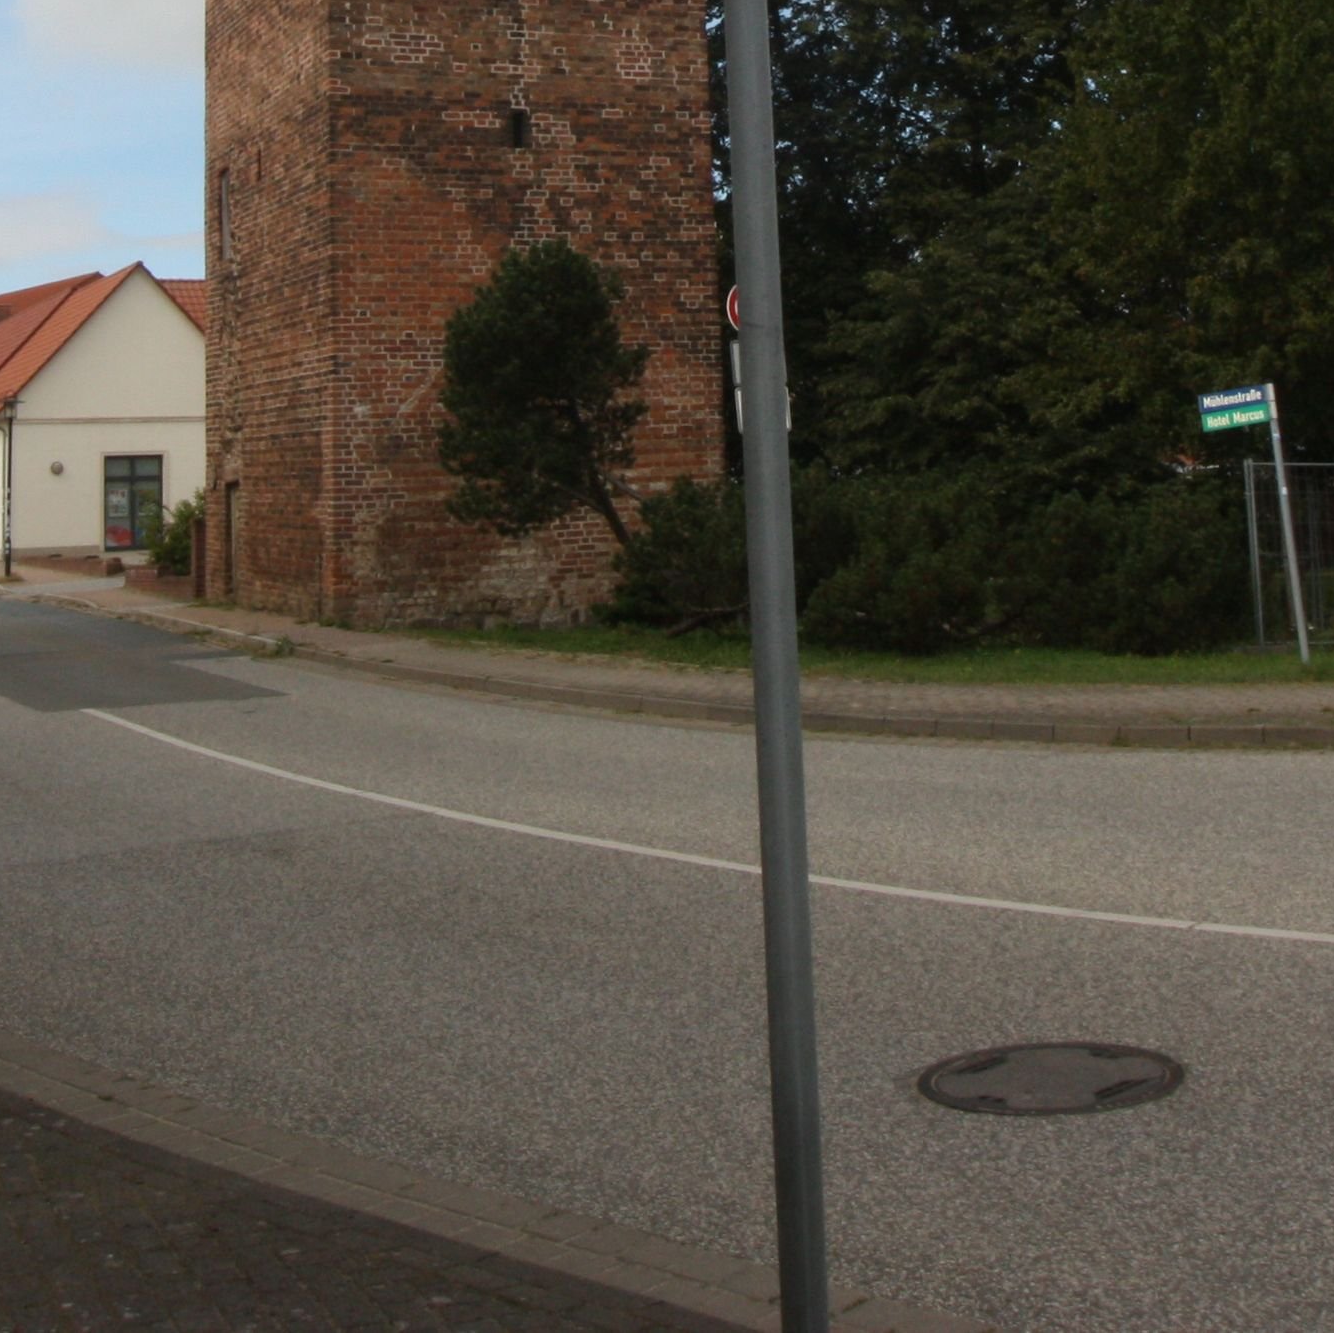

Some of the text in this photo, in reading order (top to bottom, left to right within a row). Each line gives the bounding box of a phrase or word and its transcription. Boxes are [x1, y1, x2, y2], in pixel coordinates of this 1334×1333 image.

[1203, 389, 1262, 409] Mühlenstraße
[1207, 410, 1264, 428] Hotel Marcus
